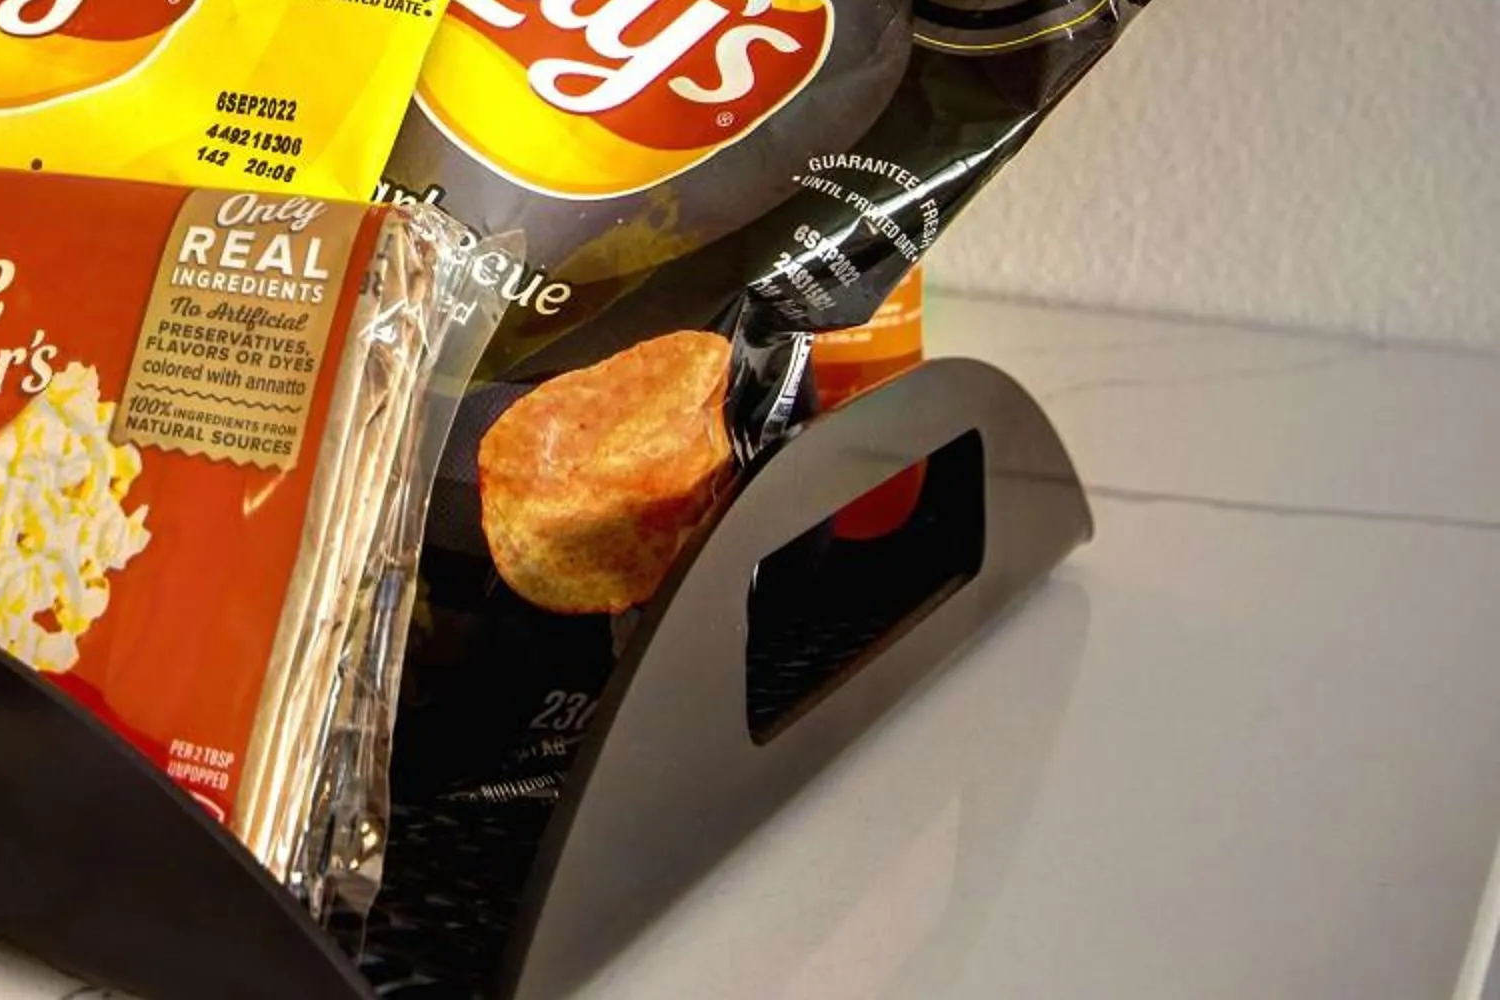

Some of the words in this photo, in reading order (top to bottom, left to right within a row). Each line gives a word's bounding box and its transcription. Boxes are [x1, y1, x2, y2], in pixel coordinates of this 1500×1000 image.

[217, 91, 297, 121] 6SEP2022
[197, 146, 230, 167] 142
[808, 153, 924, 195] GUARANTEE
[801, 175, 842, 199] UNTIL
[217, 194, 327, 232] Only
[178, 226, 329, 279] REAL
[171, 267, 324, 303] INGREDIENTS
[171, 297, 200, 317] No
[206, 301, 308, 331] Artificial
[146, 337, 229, 361] FLAVORS
[236, 351, 263, 367] OR
[268, 355, 314, 373] DYES
[142, 359, 202, 381] colored
[206, 367, 242, 388] with
[245, 374, 306, 395] annatto
[129, 395, 171, 418] 100%
[173, 409, 259, 432] INGREDIENTS
[263, 422, 297, 437] FROM
[125, 415, 204, 441] NATURAL
[211, 430, 293, 455] SOURCES
